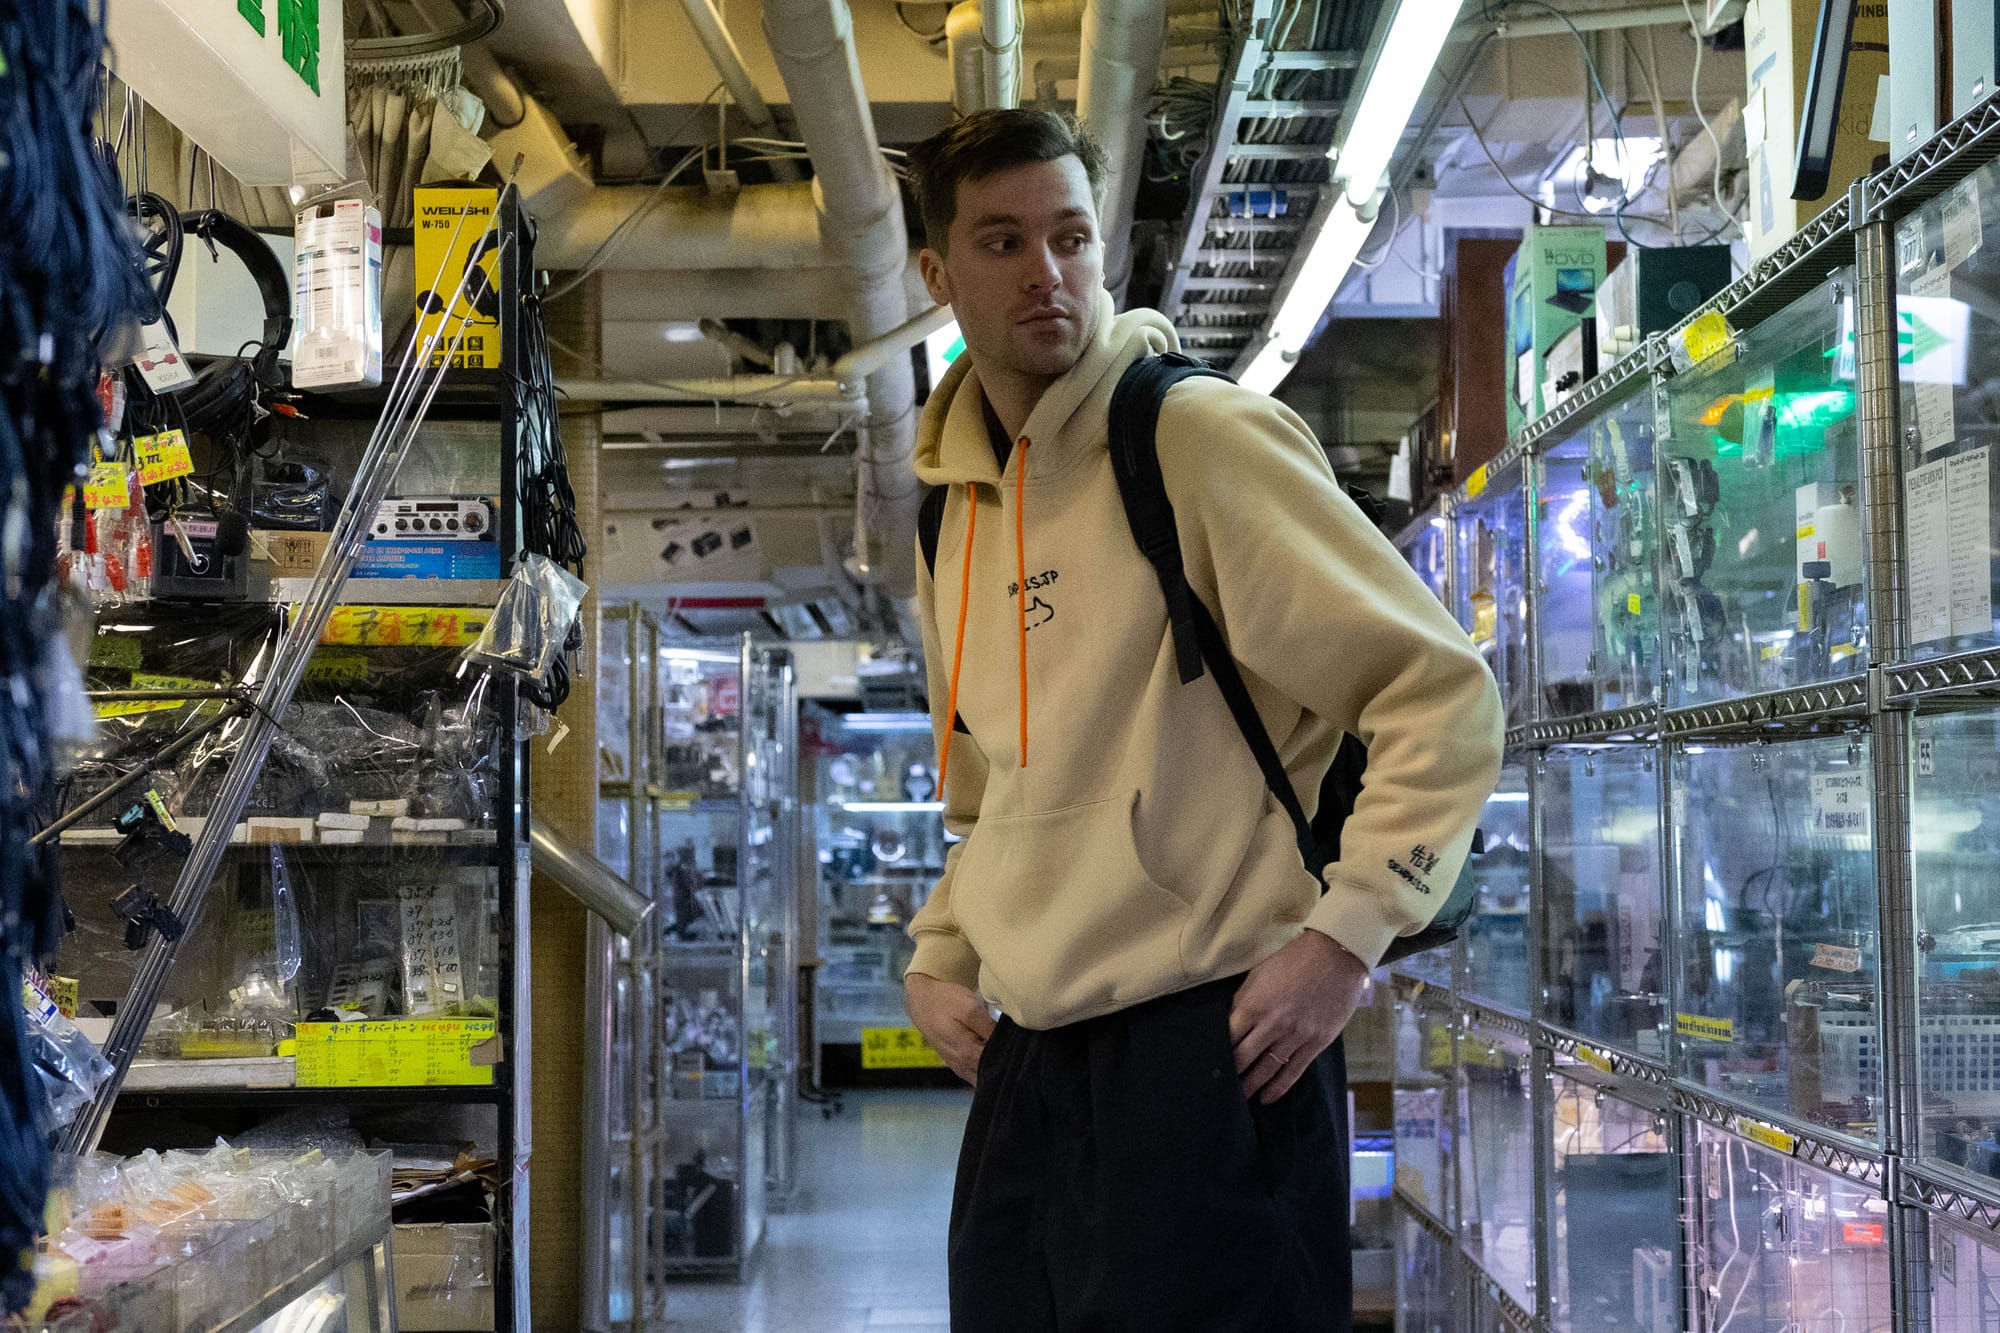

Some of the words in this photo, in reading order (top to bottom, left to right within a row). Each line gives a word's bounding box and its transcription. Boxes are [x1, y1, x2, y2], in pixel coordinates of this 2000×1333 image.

[422, 206, 490, 216] WEILISHI
[422, 219, 450, 229] W-750
[1920, 742, 1931, 771] 55
